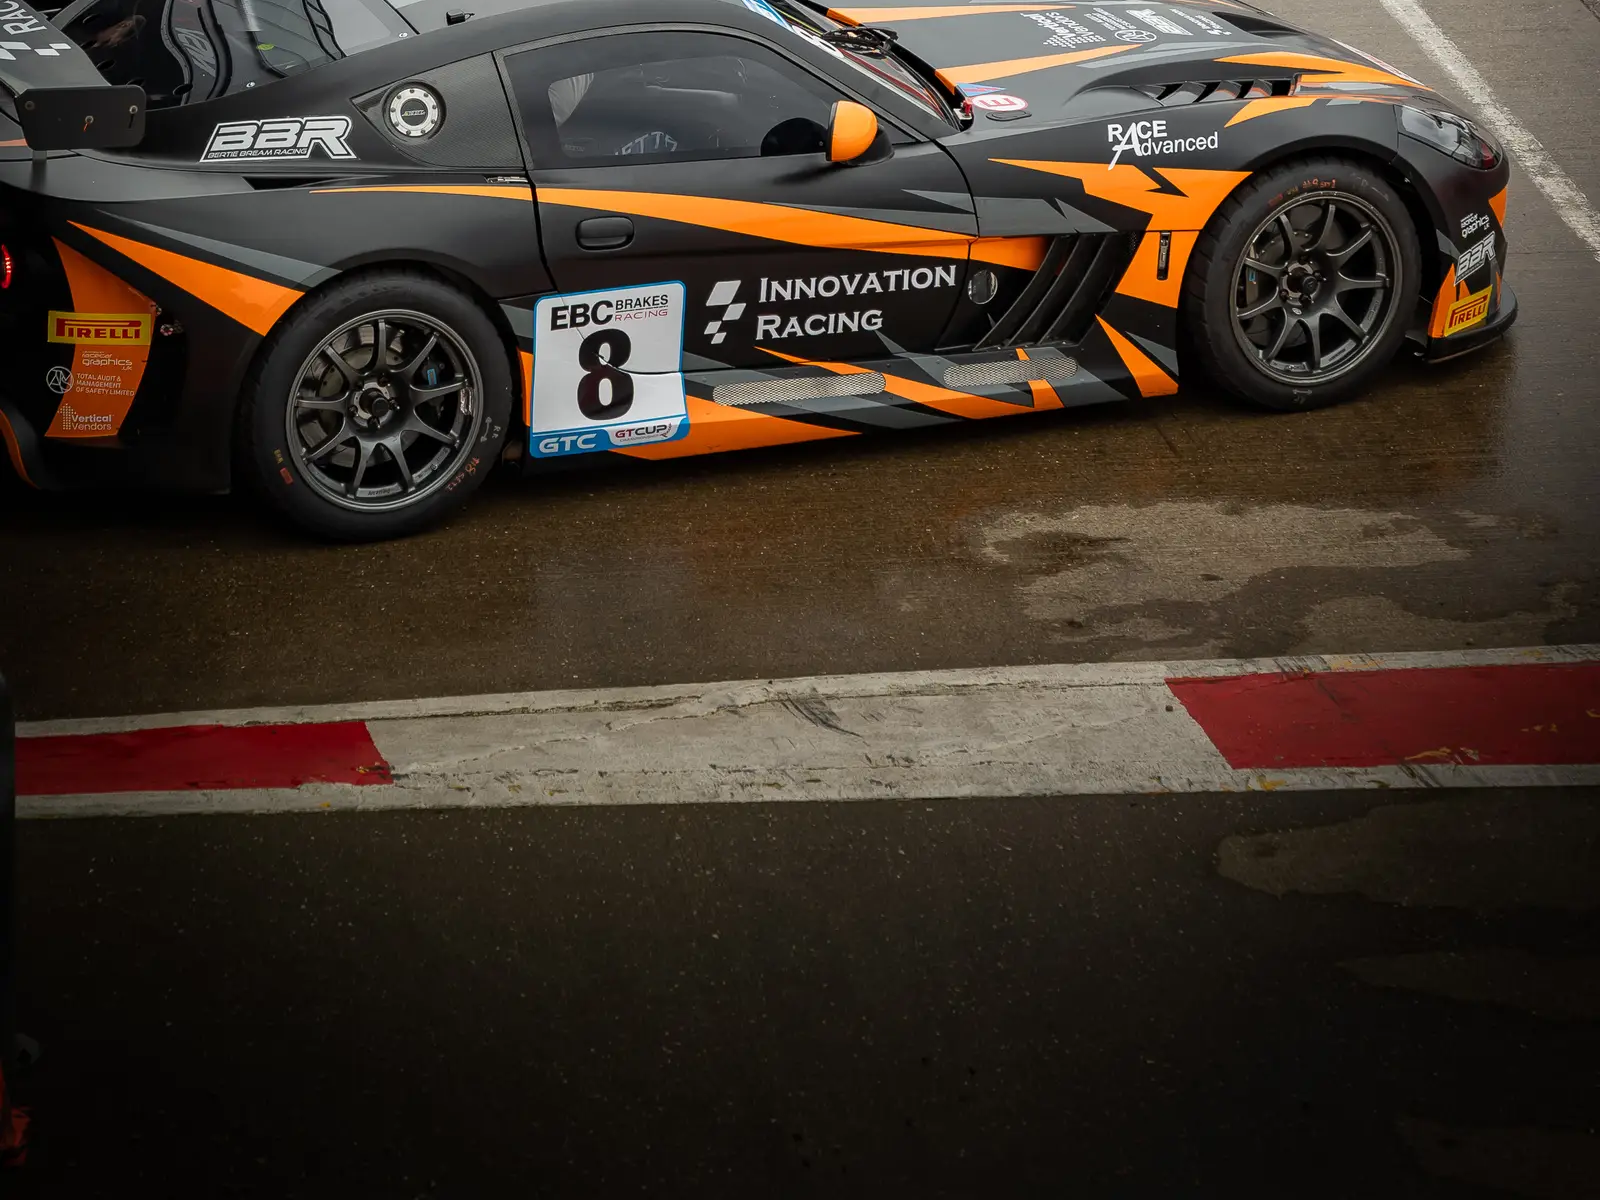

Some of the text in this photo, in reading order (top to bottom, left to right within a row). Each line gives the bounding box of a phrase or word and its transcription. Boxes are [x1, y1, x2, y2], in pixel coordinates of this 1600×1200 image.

[208, 119, 350, 157] BBR
[1108, 120, 1167, 142] RACE
[207, 151, 238, 159] BERTIE
[273, 148, 307, 156] RACING
[1108, 127, 1219, 170] Advanced
[1457, 233, 1495, 279] BBR
[759, 265, 957, 303] INNOVATION
[550, 294, 668, 331] EBC BRAKES
[614, 309, 668, 323] RACING
[1449, 294, 1488, 328] PIRELLI
[56, 318, 142, 339] PIRELLI
[755, 309, 883, 341] RACING
[82, 358, 133, 367] graphics
[76, 380, 121, 388] MANAGEMENT
[577, 328, 635, 421] 8
[71, 414, 112, 422] Vertical
[71, 422, 112, 431] Vendors
[539, 433, 597, 453] GTC
